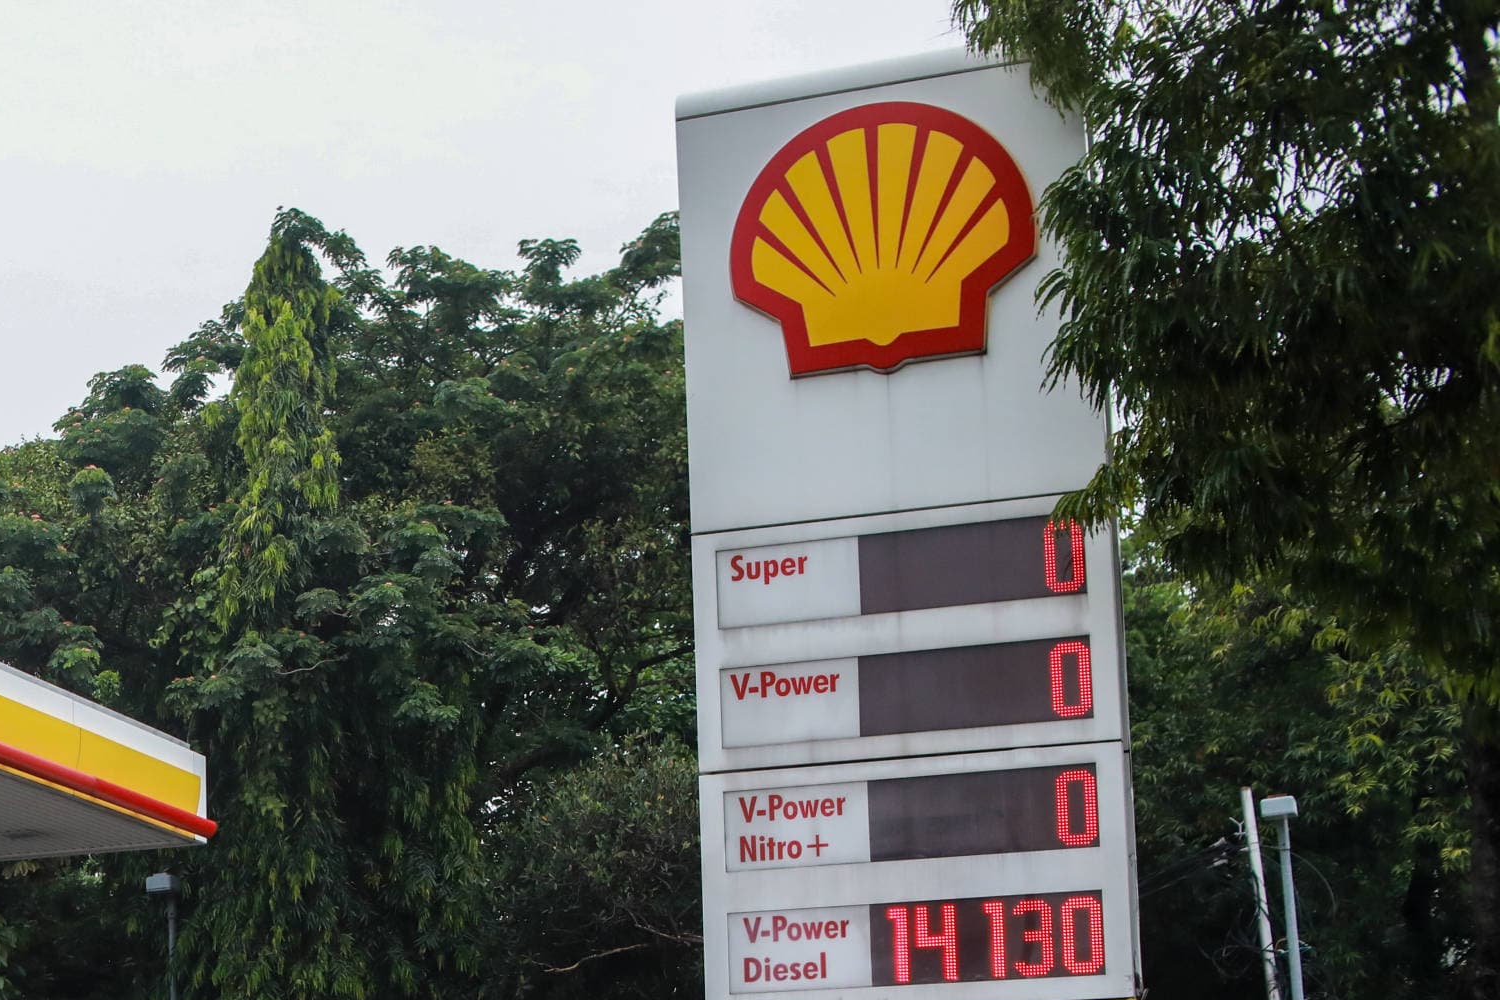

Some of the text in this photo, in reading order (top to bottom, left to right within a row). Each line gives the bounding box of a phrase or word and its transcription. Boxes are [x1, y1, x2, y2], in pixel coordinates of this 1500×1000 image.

[730, 554, 809, 585] Super
[1043, 516, 1086, 594] 0
[729, 670, 840, 701] V-Power
[1049, 640, 1093, 719] 0
[738, 794, 846, 823] V-Power
[1054, 768, 1098, 847] 0
[743, 916, 849, 944] V-Power
[743, 951, 828, 984] Diesel
